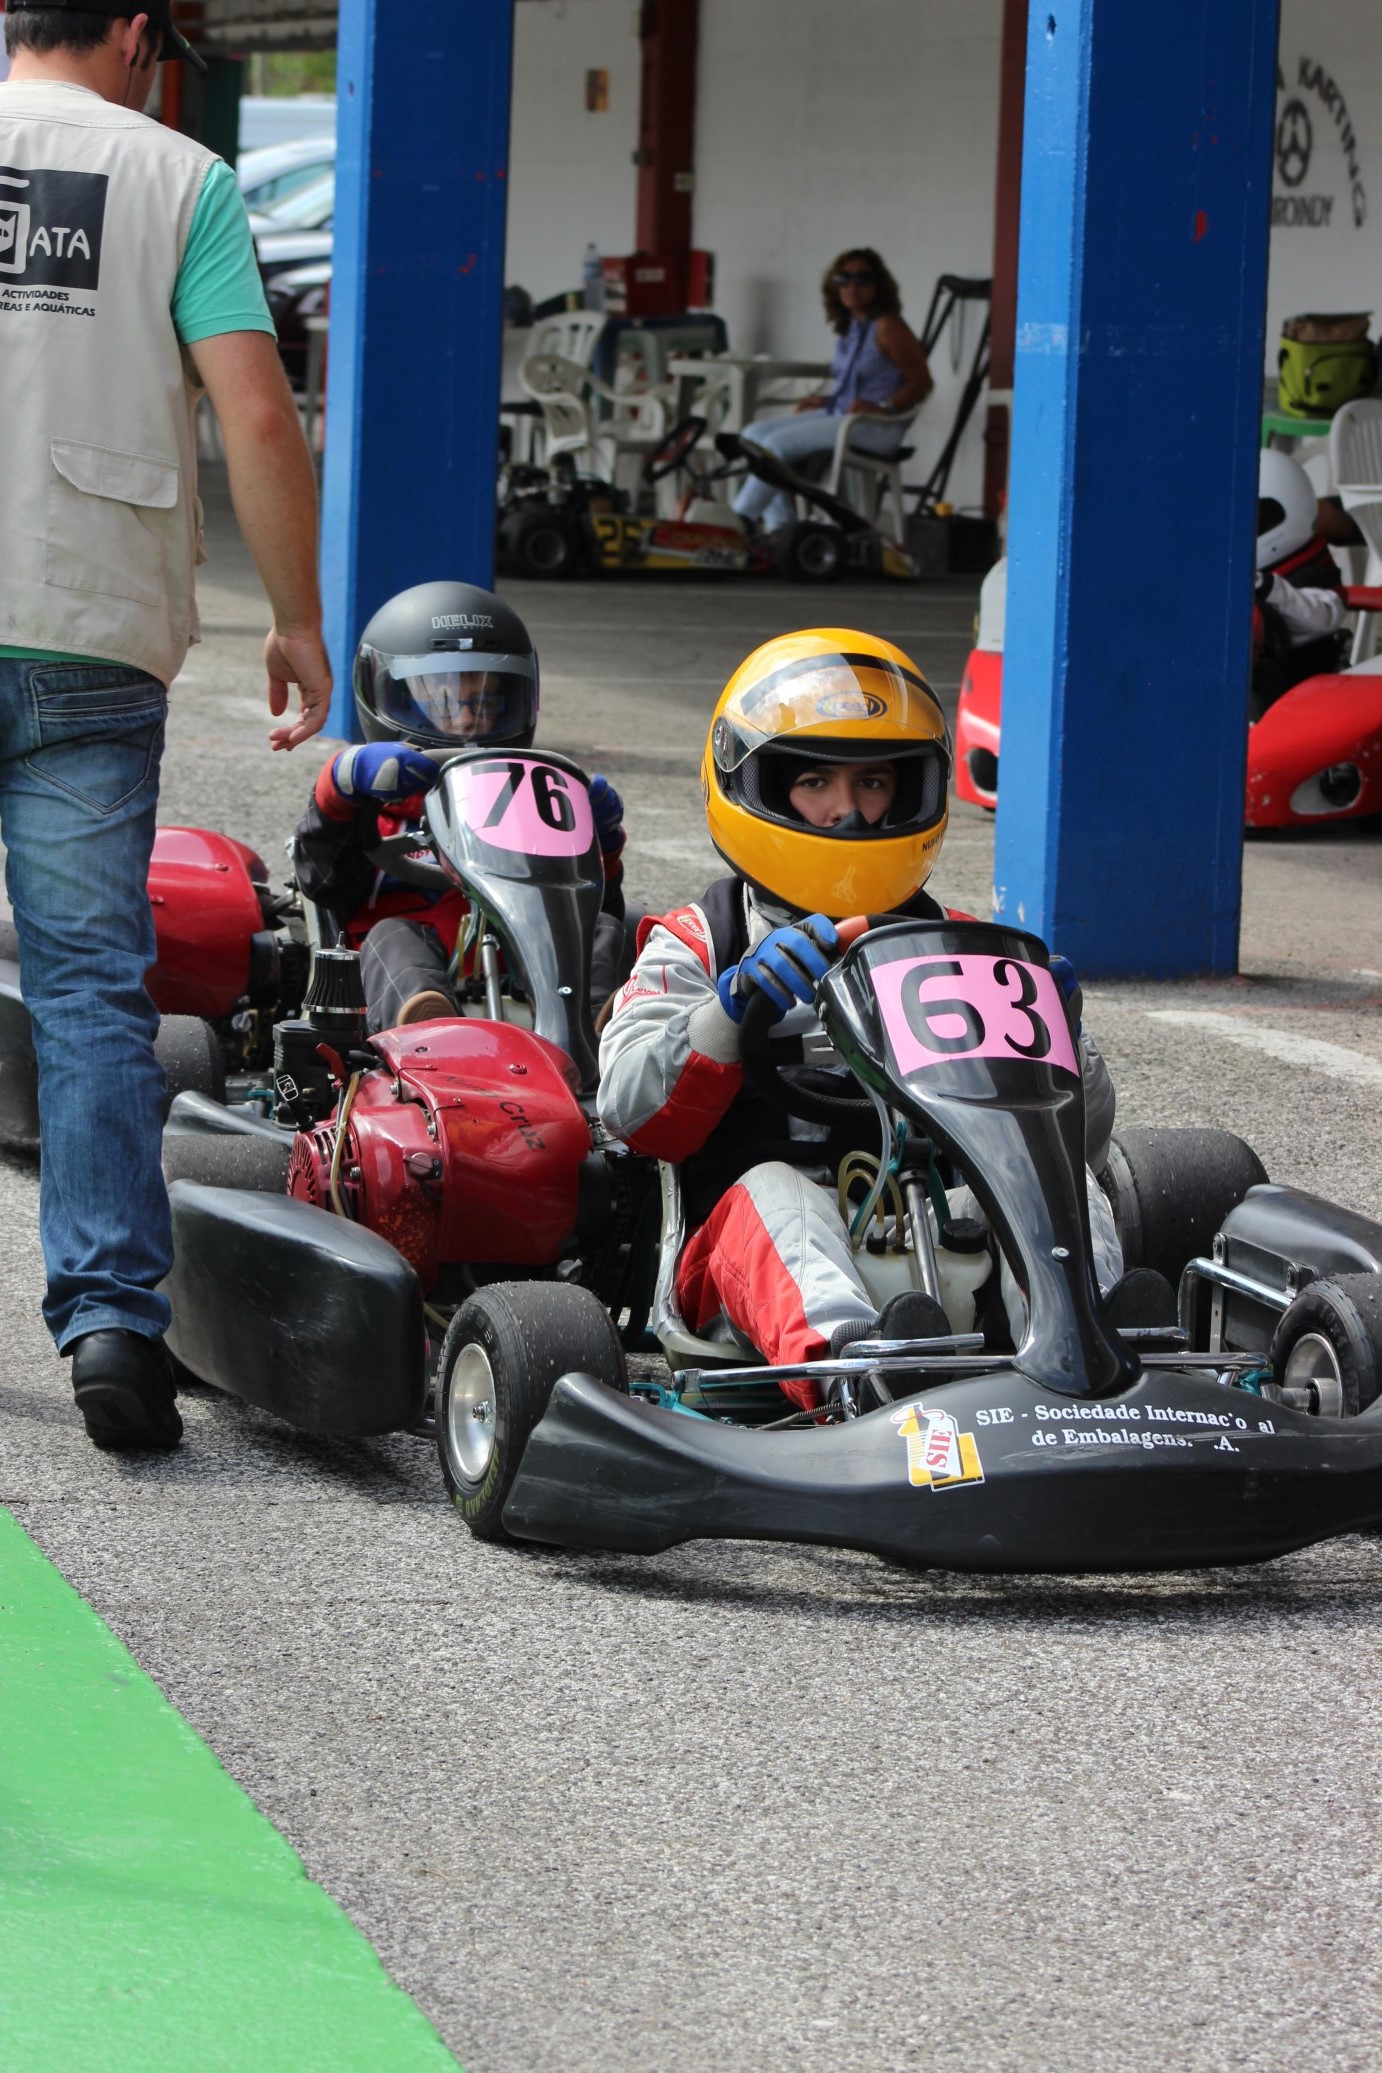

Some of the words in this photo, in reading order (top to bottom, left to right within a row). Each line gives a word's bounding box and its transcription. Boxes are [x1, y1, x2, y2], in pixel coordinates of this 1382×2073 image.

[28, 226, 91, 260] ATA
[2, 289, 70, 301] ACTIVIDADES
[25, 303, 31, 311] E
[33, 302, 96, 317] AQUÁTICAS
[431, 614, 494, 629] HELIX
[470, 761, 577, 832] 76
[900, 959, 1052, 1059] 63
[975, 1407, 1015, 1426] SIE
[1034, 1404, 1141, 1421] Sociedade
[1031, 1429, 1058, 1446] de
[926, 1429, 953, 1469] SIE
